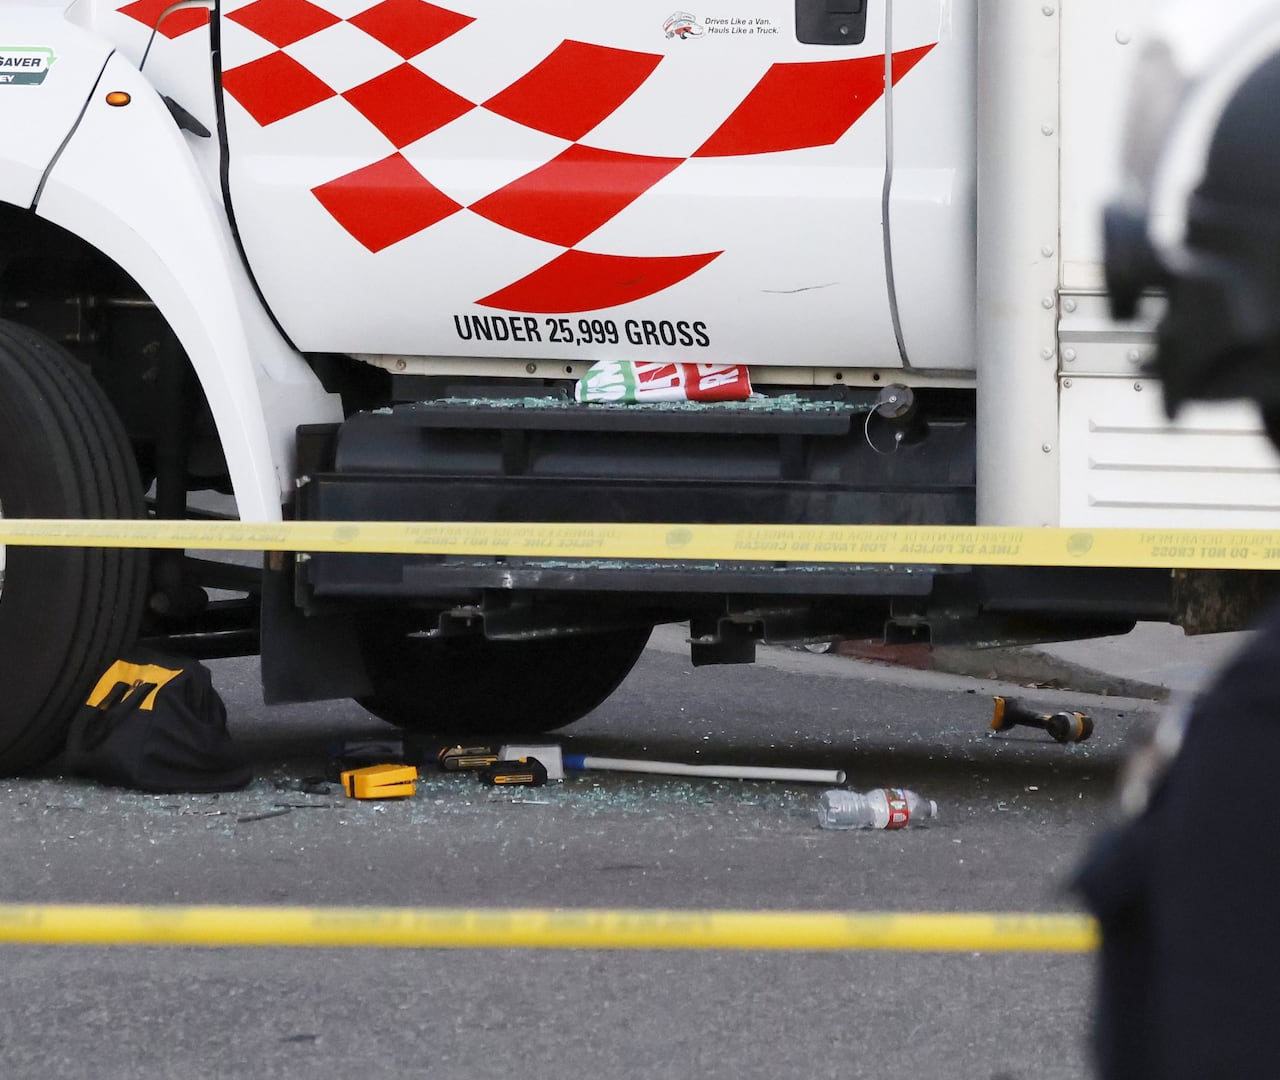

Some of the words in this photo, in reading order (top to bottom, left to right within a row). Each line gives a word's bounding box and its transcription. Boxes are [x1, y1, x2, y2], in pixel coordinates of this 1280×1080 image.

[454, 315, 542, 342] UNDER
[545, 318, 619, 346] 25,999
[625, 319, 710, 347] GROSS
